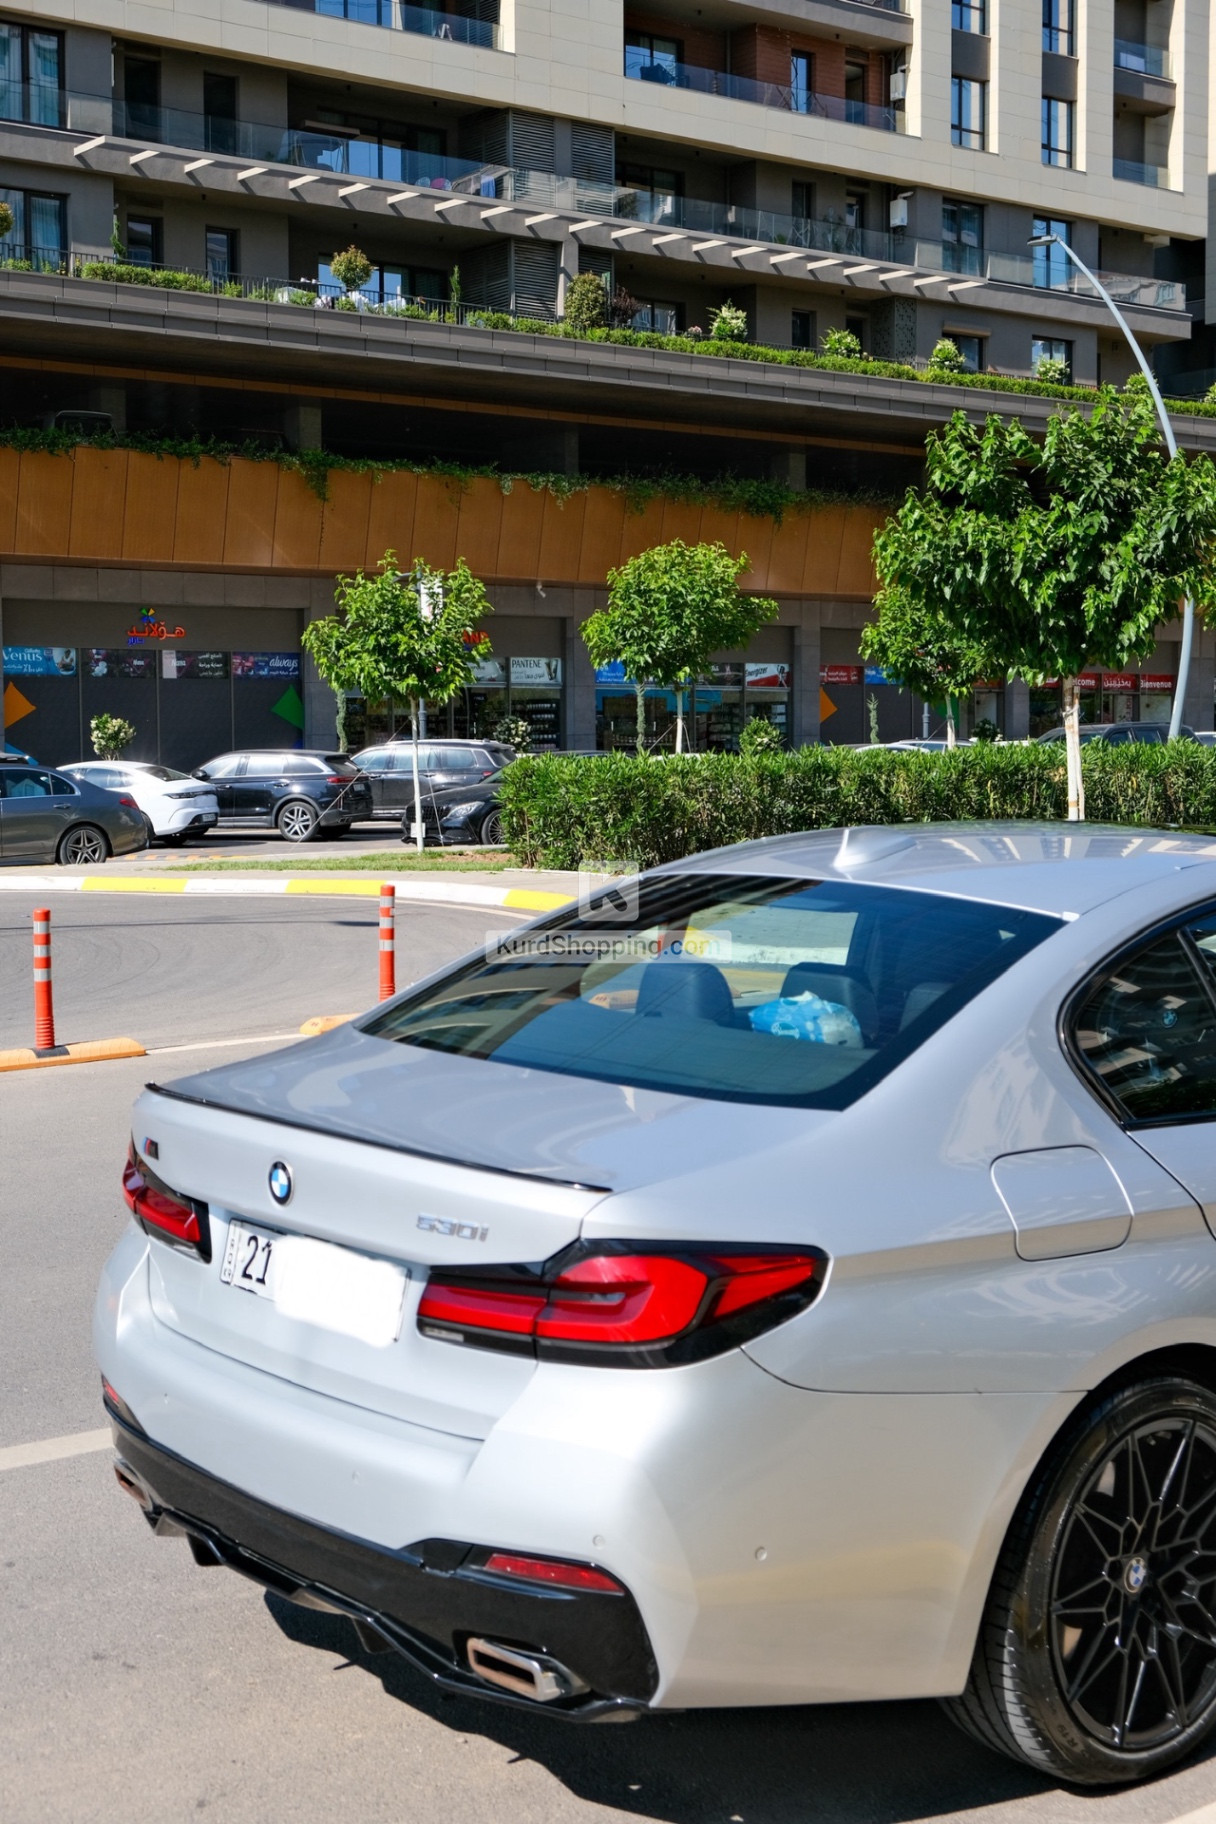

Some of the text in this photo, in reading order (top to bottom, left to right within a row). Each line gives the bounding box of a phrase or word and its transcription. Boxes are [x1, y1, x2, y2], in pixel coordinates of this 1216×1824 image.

[2, 648, 43, 661] Venus
[269, 655, 298, 671] always
[511, 659, 542, 668] PANTENE
[1140, 679, 1172, 688] Bienvenue
[416, 1212, 490, 1242] 530i
[241, 1235, 272, 1285] 21
